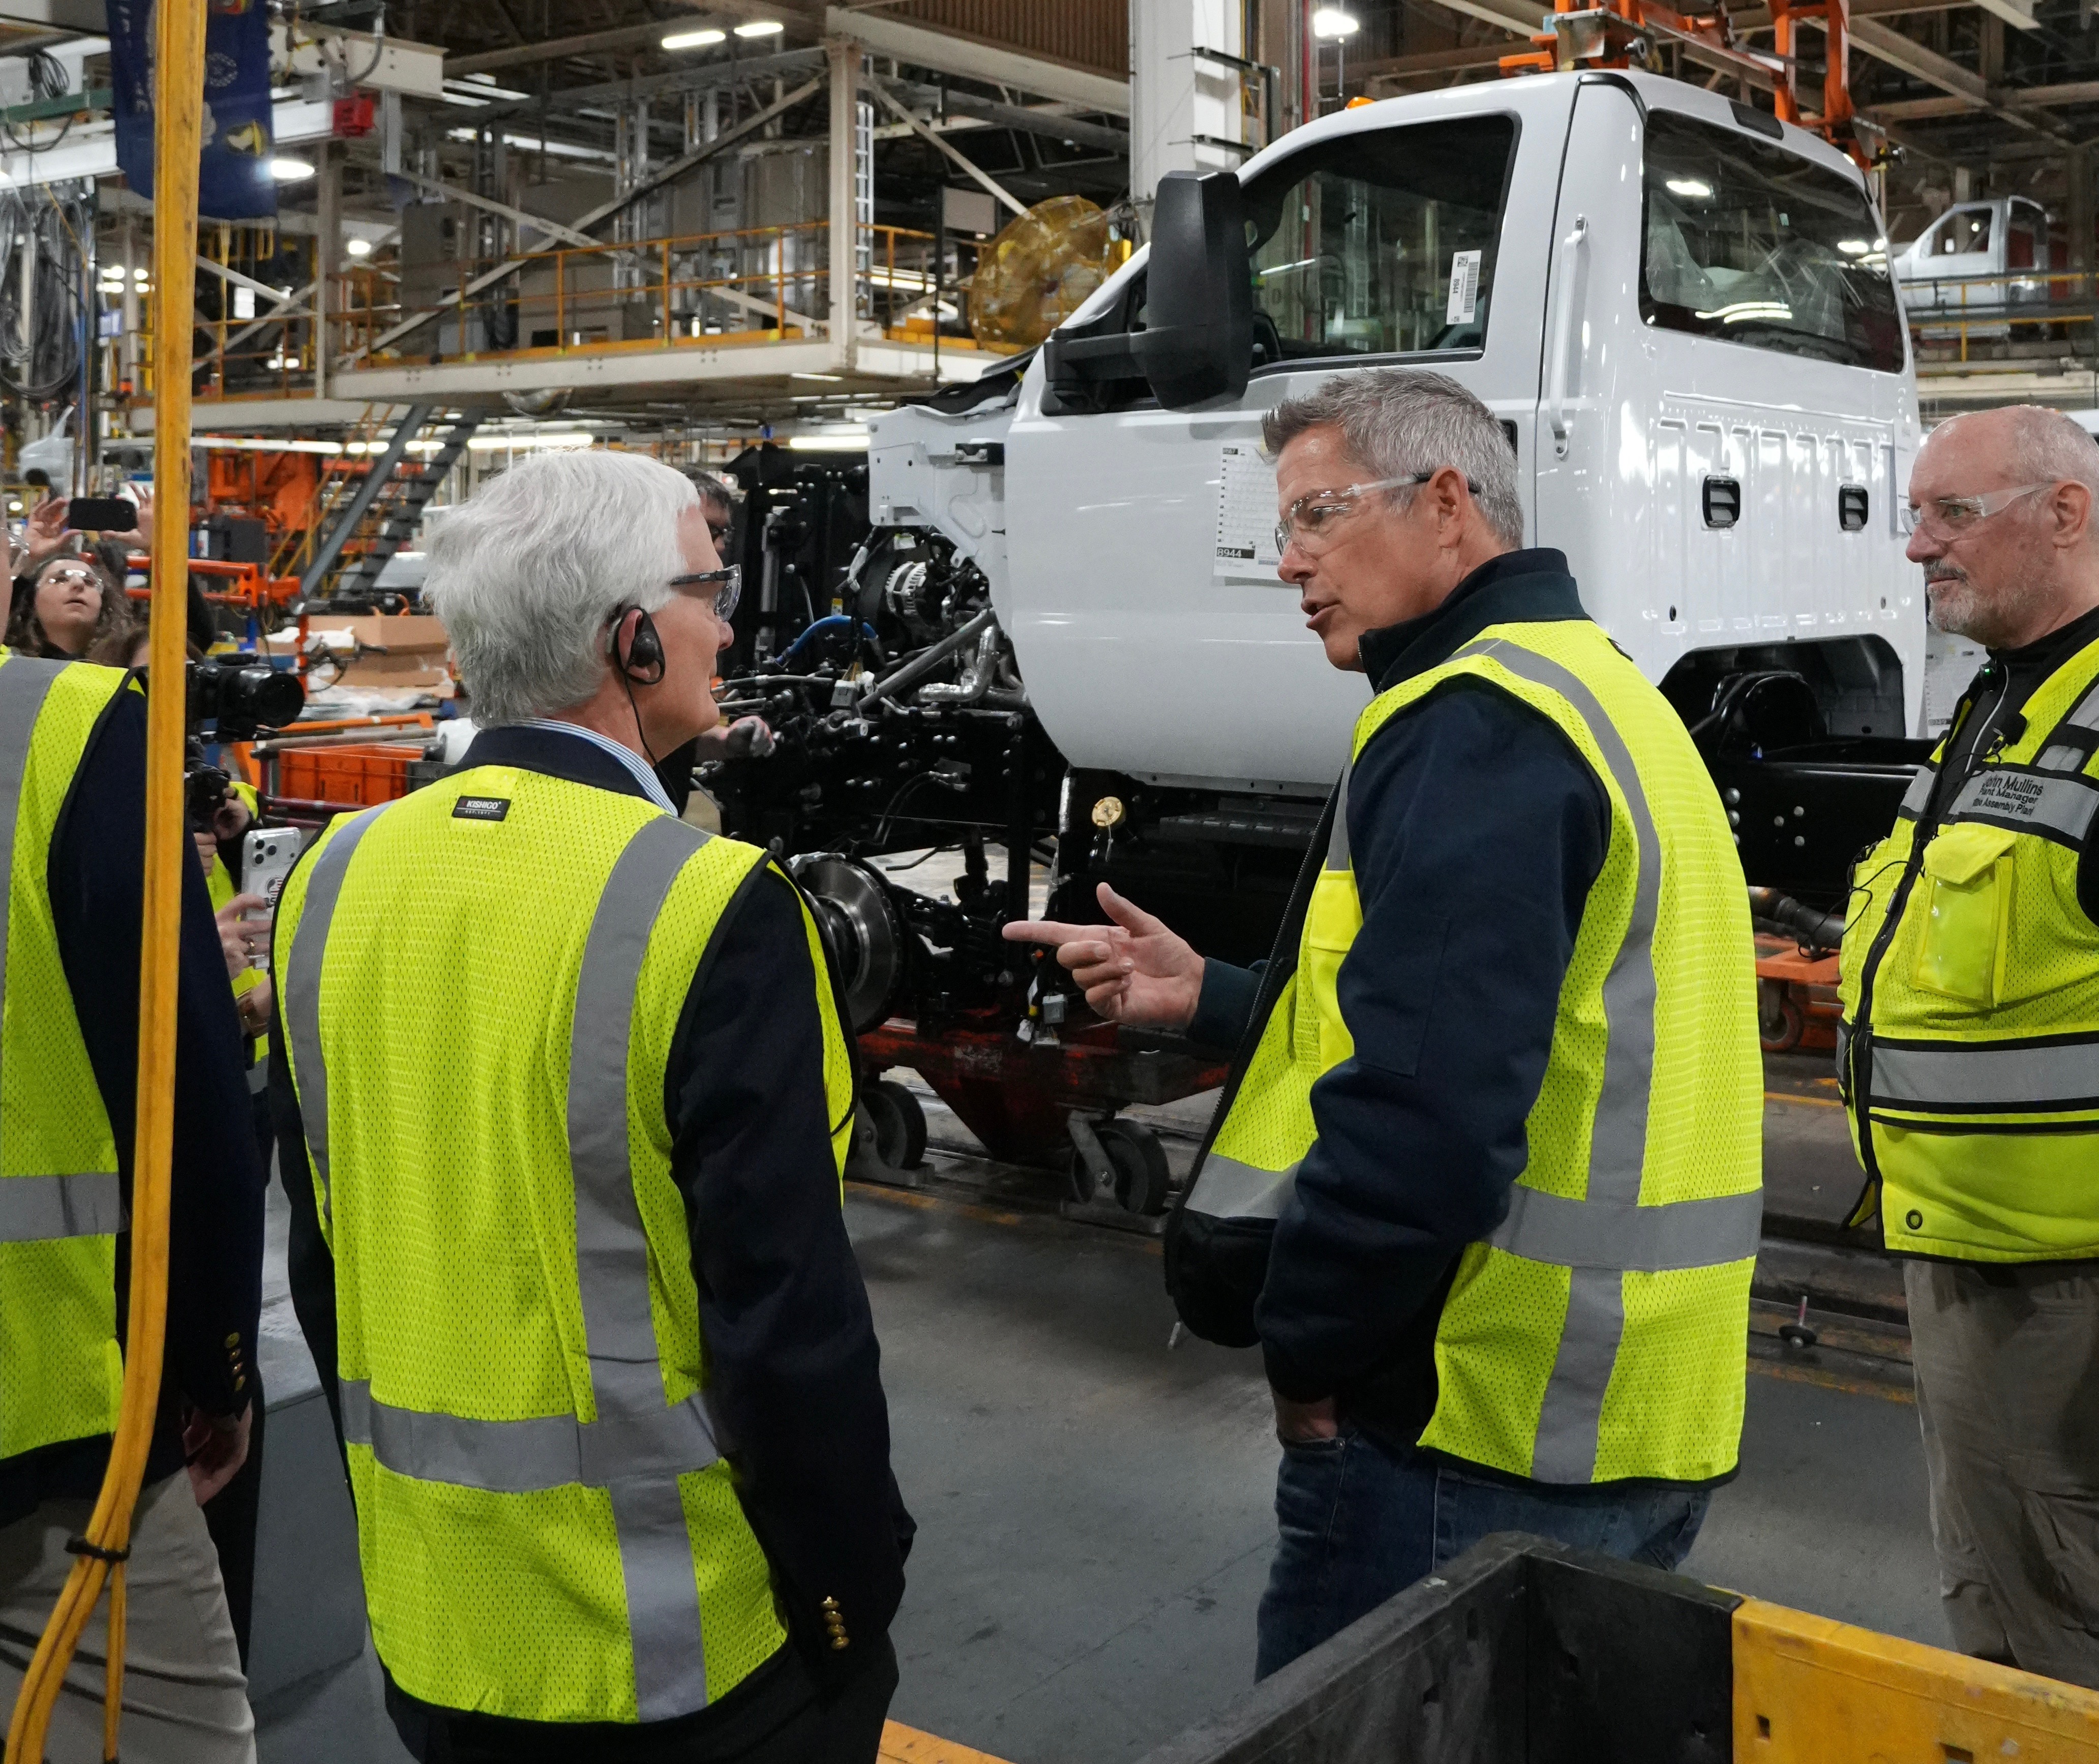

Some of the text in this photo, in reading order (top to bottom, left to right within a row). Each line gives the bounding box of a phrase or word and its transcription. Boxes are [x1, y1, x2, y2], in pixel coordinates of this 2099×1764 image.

[1217, 548, 1242, 558] 8944
[2002, 775, 2044, 796] Mullins
[1996, 788, 2038, 804] Manager
[467, 800, 498, 810] KISHIGO
[1983, 797, 2016, 813] Assembly
